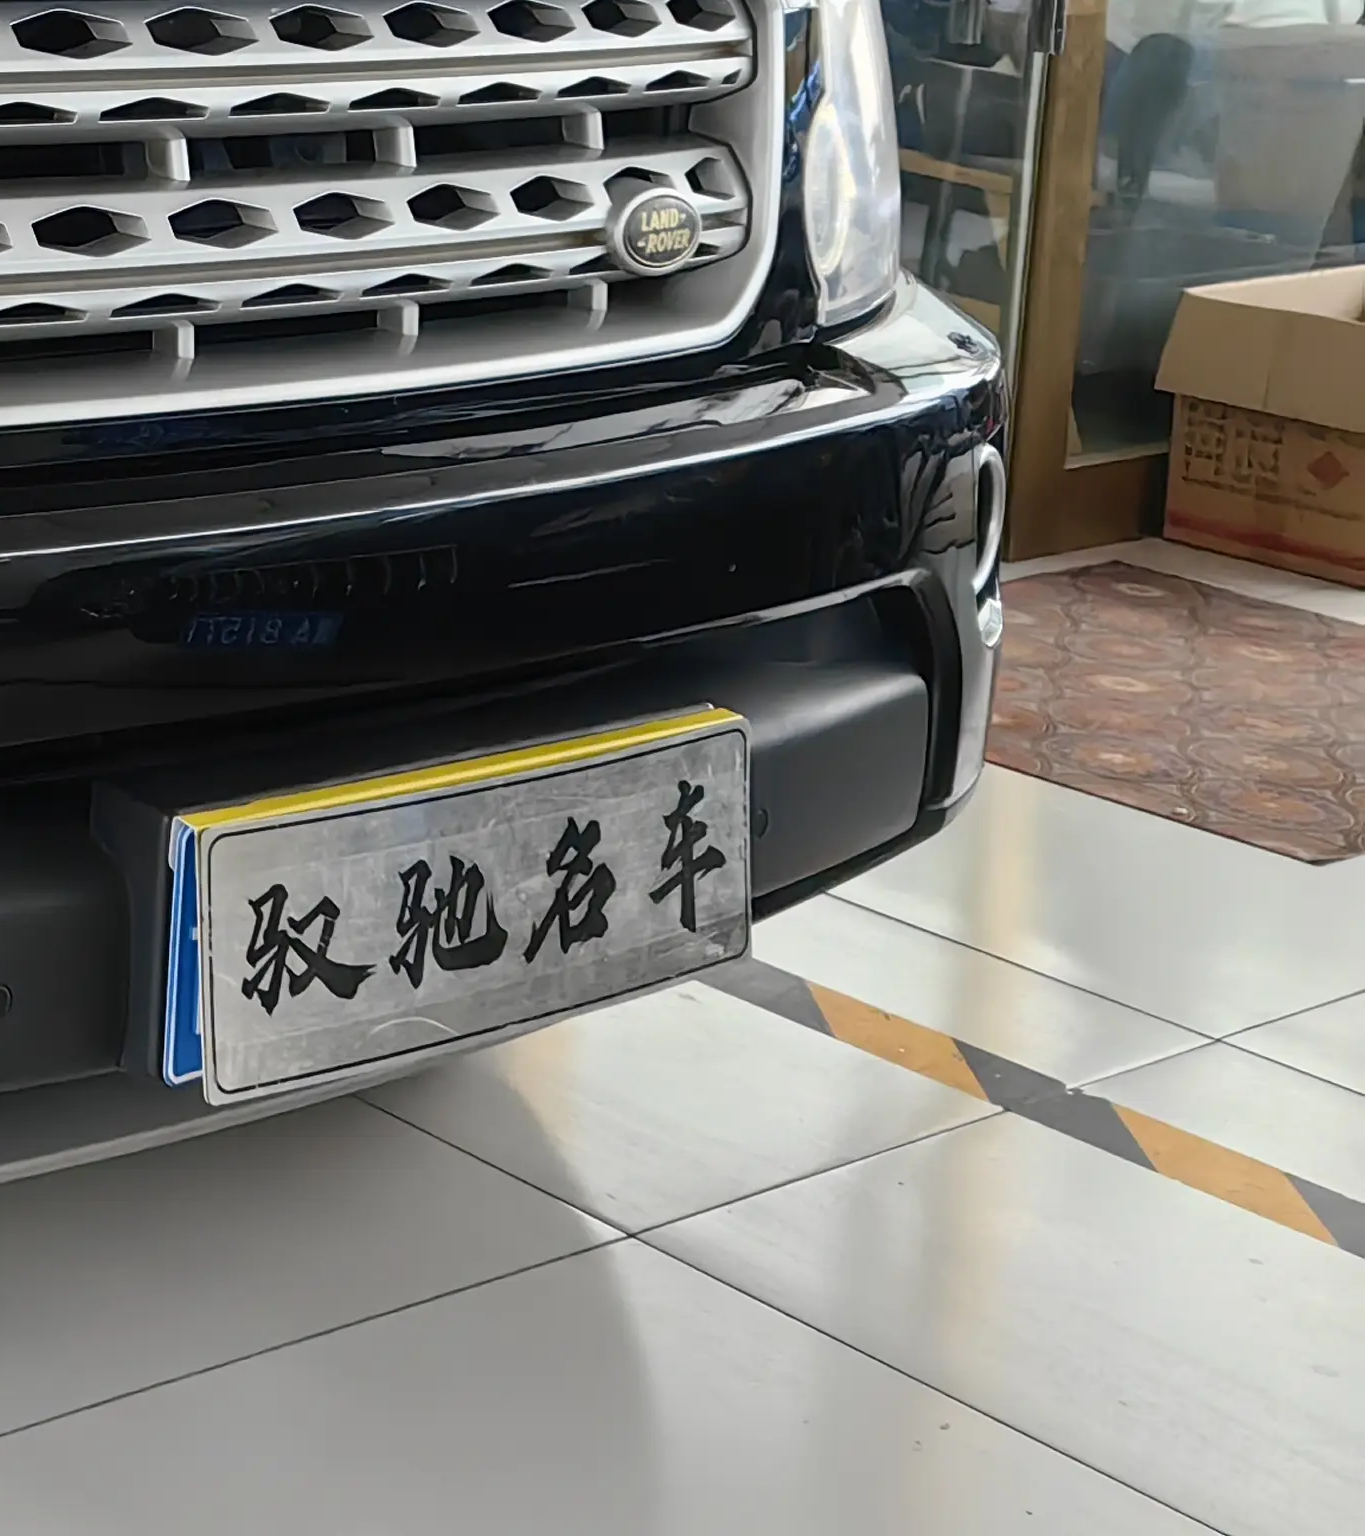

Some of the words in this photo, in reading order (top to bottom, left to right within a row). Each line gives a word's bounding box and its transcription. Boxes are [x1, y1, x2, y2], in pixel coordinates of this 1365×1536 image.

[640, 207, 680, 232] LAND
[645, 228, 691, 254] ROVER
[240, 779, 728, 1017] 驭驰名车
